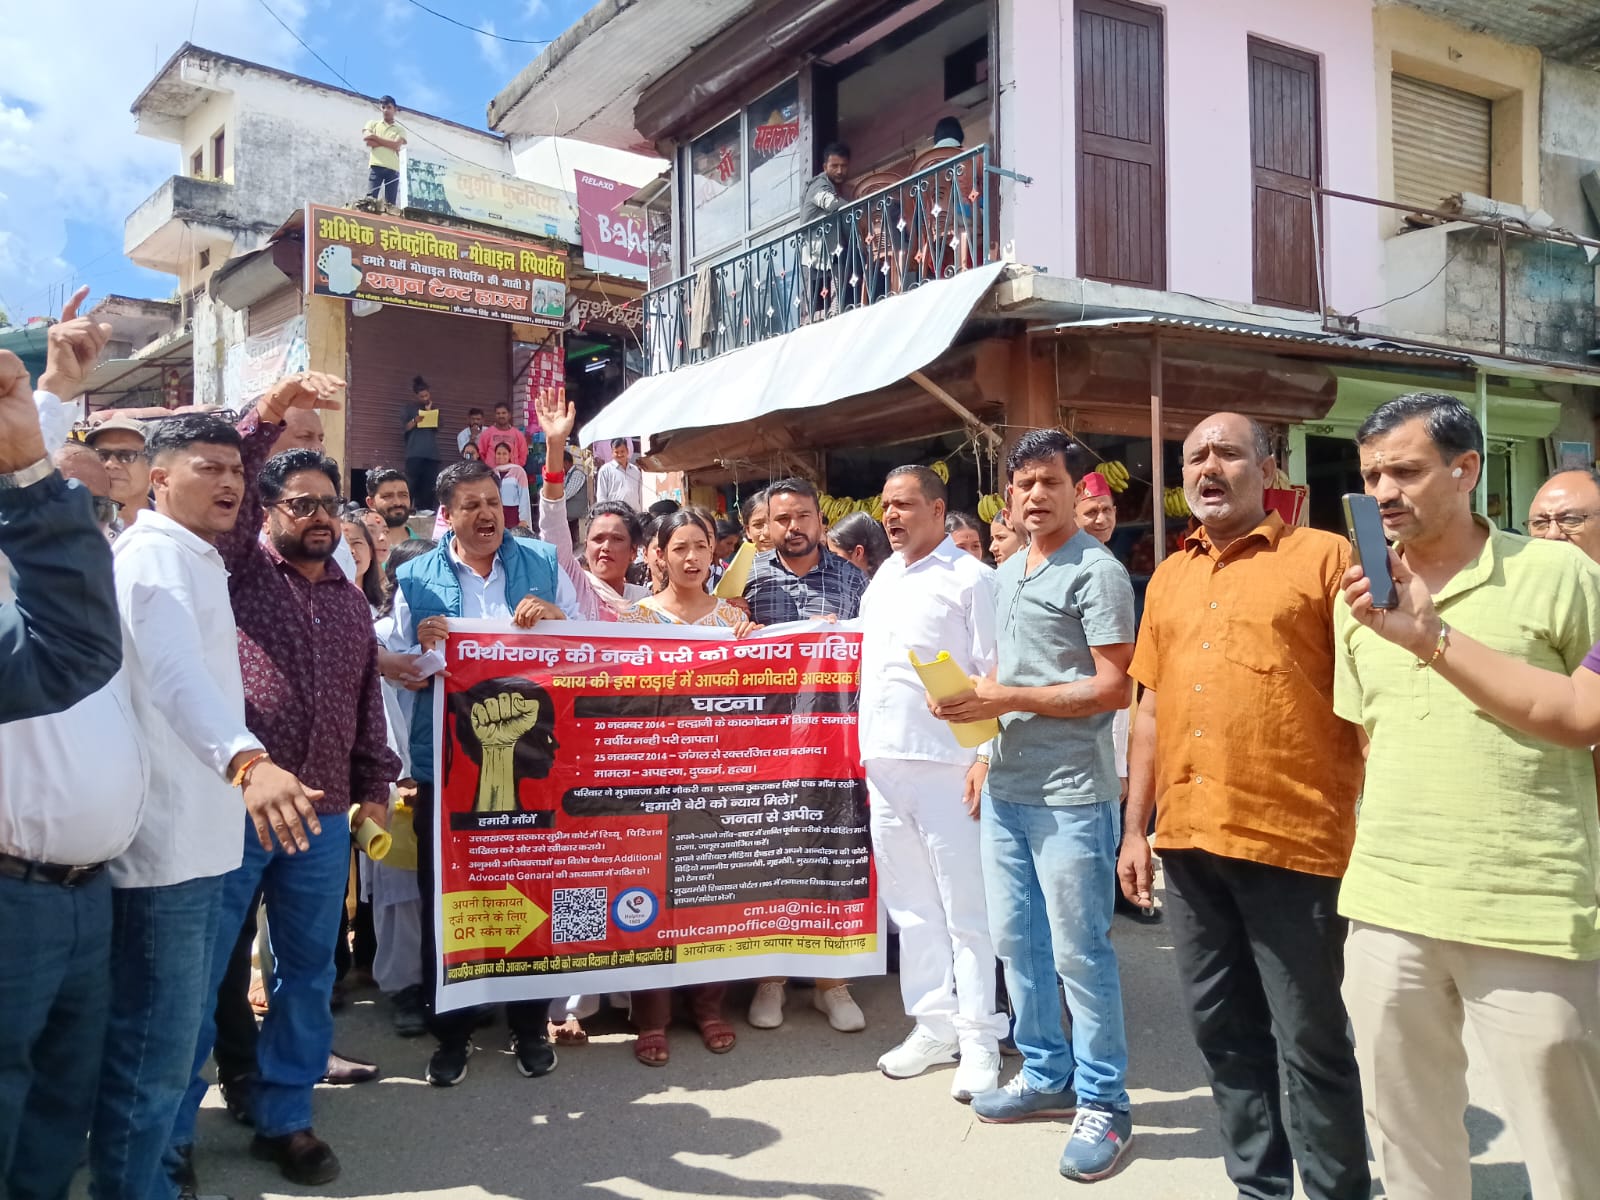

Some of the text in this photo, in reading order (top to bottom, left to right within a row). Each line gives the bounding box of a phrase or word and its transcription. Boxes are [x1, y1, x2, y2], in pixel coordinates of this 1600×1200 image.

[581, 175, 614, 191] RELAXO
[319, 216, 375, 245] अभिषेक
[469, 242, 515, 271] मोबाइल
[520, 250, 565, 279] रिपेयरिंग
[362, 255, 385, 267] हमारे
[411, 262, 445, 277] मोबाइल
[449, 267, 484, 283] रिपेयरिंग
[487, 274, 499, 286] की
[502, 278, 522, 290] जाती
[525, 279, 531, 291] है
[366, 272, 426, 295] शगुन
[429, 278, 472, 301] टैन्ट
[475, 288, 528, 310] हाउस
[565, 644, 596, 663] की
[601, 645, 653, 665] नन्ही
[659, 646, 693, 663] परी
[699, 647, 729, 660] को
[734, 643, 794, 660] न्याय
[799, 636, 860, 660] चाहिए
[552, 668, 852, 691] न्याय की इस लड़ाई में आपकी भागीदारी आवश्यक
[691, 697, 765, 712] घटना
[608, 721, 644, 729] नवम्बर
[645, 721, 665, 729] 2014
[715, 717, 725, 727] के
[728, 717, 777, 726] काठगोदाम
[780, 715, 791, 725] में
[792, 715, 819, 725] विवाह
[595, 738, 600, 746] 7
[604, 735, 631, 745] वर्षीय
[634, 735, 659, 744] नन्ही
[662, 734, 678, 744] परी
[594, 754, 605, 762] 25
[608, 753, 644, 761] नवम्बर
[678, 750, 708, 759] जंगल
[711, 749, 720, 759] से
[722, 748, 771, 758] रक्तरंजित
[594, 769, 630, 778] मामला
[574, 788, 602, 796] परिवार
[605, 788, 612, 796] ने
[654, 786, 670, 795] और
[718, 783, 743, 795] प्रस्ताव
[685, 797, 761, 810] बेटी को न्याय
[479, 815, 510, 827] हमारी
[721, 806, 824, 824] जनता से अपील
[516, 833, 545, 841] सरकार
[546, 832, 570, 842] सुप्रीम
[572, 830, 589, 839] कोर्ट
[469, 846, 498, 855] दाखिल
[515, 844, 530, 853] और
[532, 844, 546, 852] उसे
[555, 858, 565, 866] का
[614, 853, 662, 863] Additional
[469, 872, 514, 882] Advocate
[556, 870, 567, 879] की
[453, 897, 523, 909] अपनी शिकायत
[744, 902, 864, 916] cm.ua@nic.in तथा
[449, 910, 527, 926] दर्ज करने के लिए
[455, 924, 521, 939] QR करें
[657, 917, 862, 938] cmukcampoffice@gmail.com
[684, 937, 866, 956] आयोजक उद्योग व्यापार मंडल पिथौरागढ़
[475, 962, 494, 975] समाज
[496, 959, 505, 974] की
[533, 958, 548, 972] नन्ही
[550, 958, 560, 970] परी
[562, 957, 570, 970] को
[572, 957, 586, 968] न्याय
[588, 953, 610, 967] दिलाना
[611, 951, 617, 965] ही
